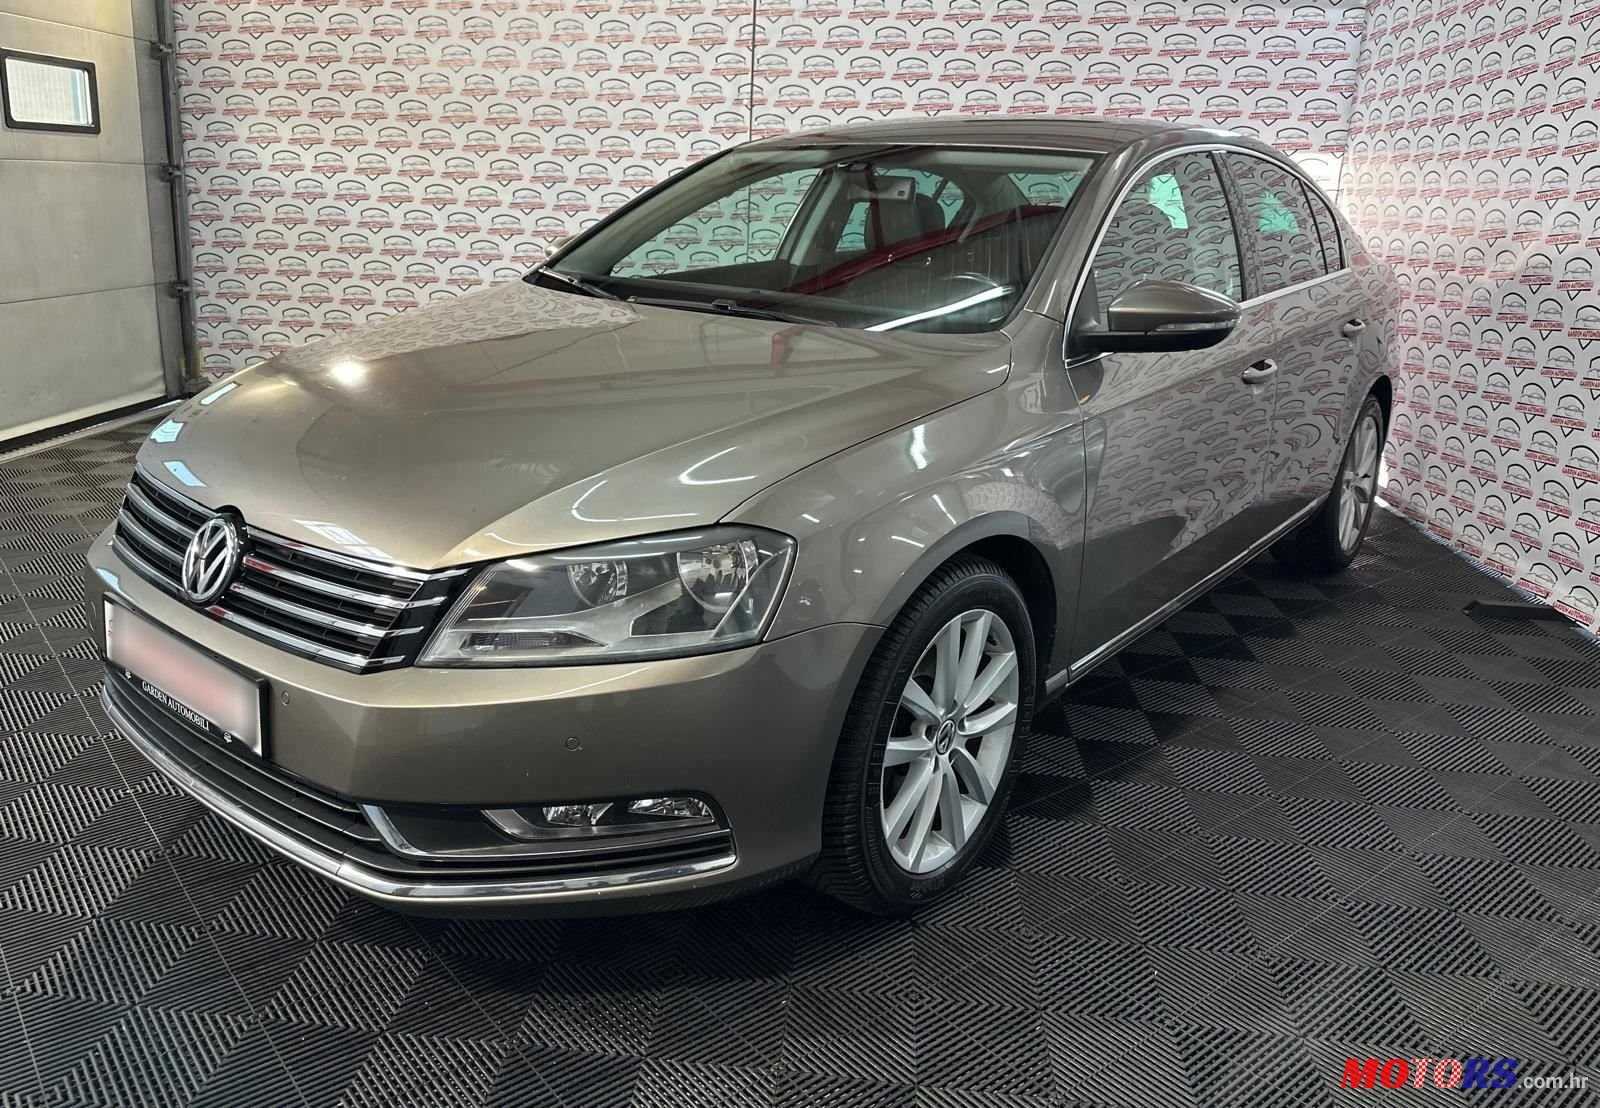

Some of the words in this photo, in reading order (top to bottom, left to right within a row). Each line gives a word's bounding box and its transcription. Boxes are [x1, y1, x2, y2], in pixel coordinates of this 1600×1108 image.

[1553, 602, 1568, 612] GARDEN
[1568, 608, 1594, 624] AUTOMOBILI
[142, 681, 167, 704] GARDEN
[167, 698, 210, 731] AUTOMOBILI
